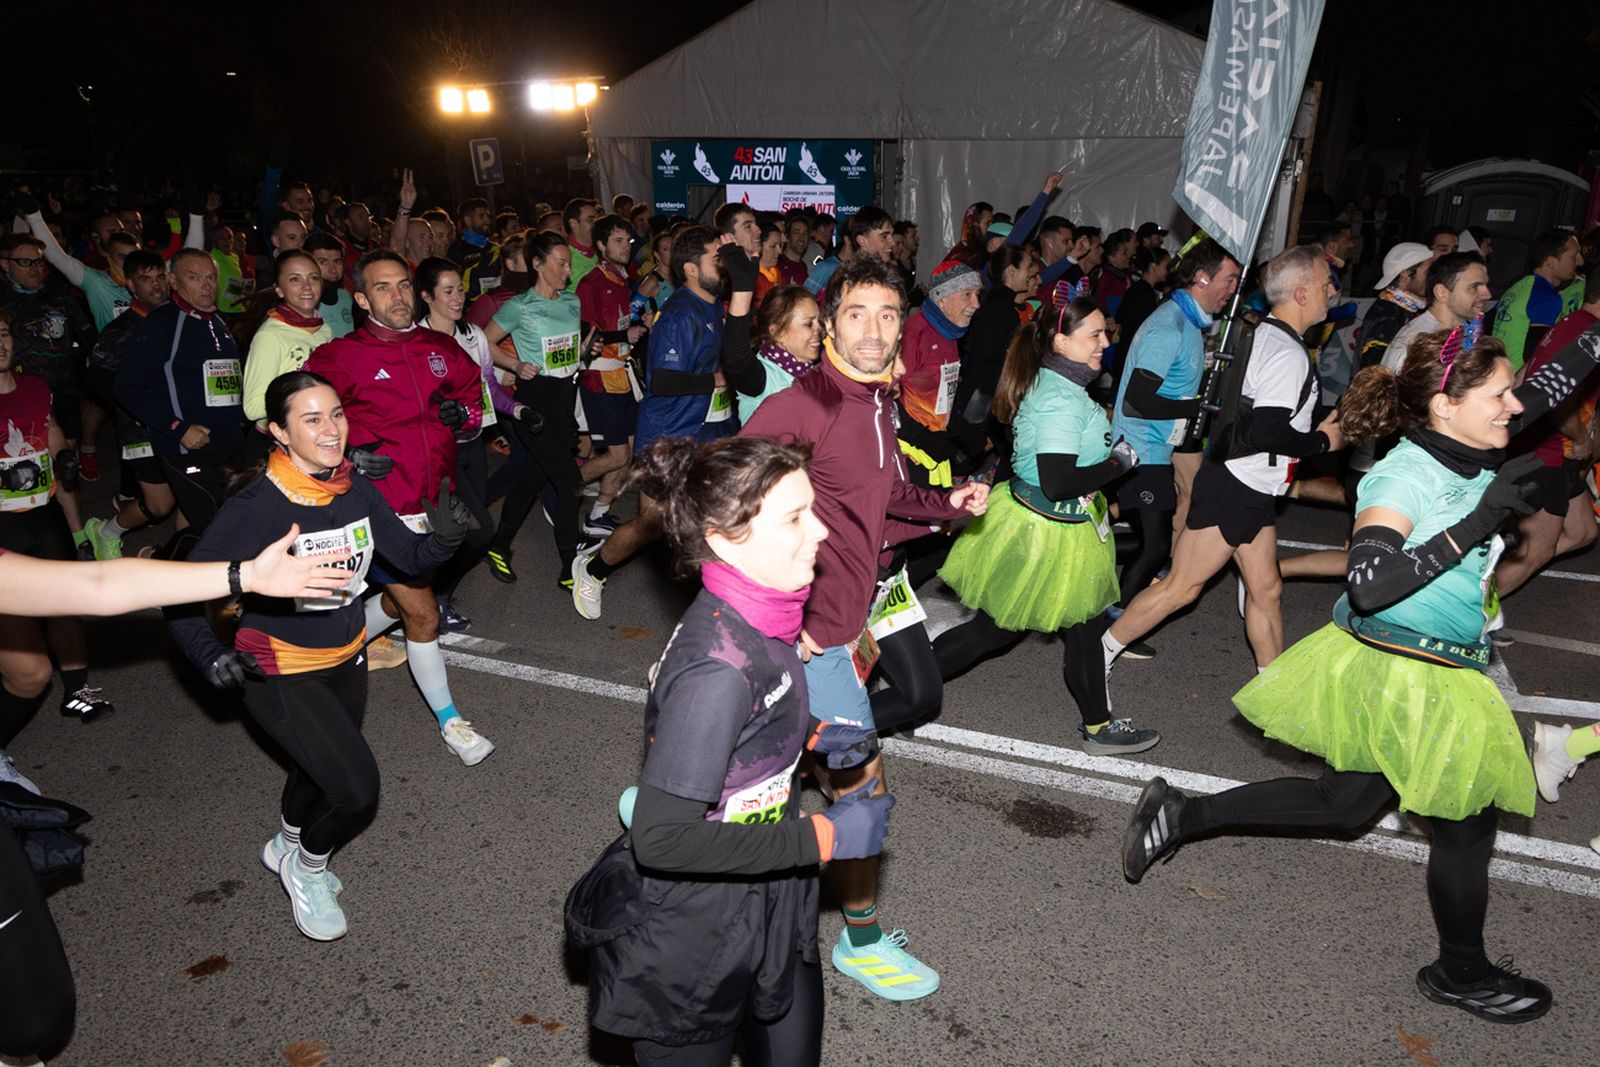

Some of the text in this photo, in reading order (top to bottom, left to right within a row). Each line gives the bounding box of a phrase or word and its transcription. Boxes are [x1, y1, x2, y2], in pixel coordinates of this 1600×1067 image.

[477, 145, 496, 170] P
[732, 147, 787, 164] 43 SAN
[701, 165, 711, 177] 43
[730, 161, 784, 181] ANTÓN
[807, 165, 818, 178] 43
